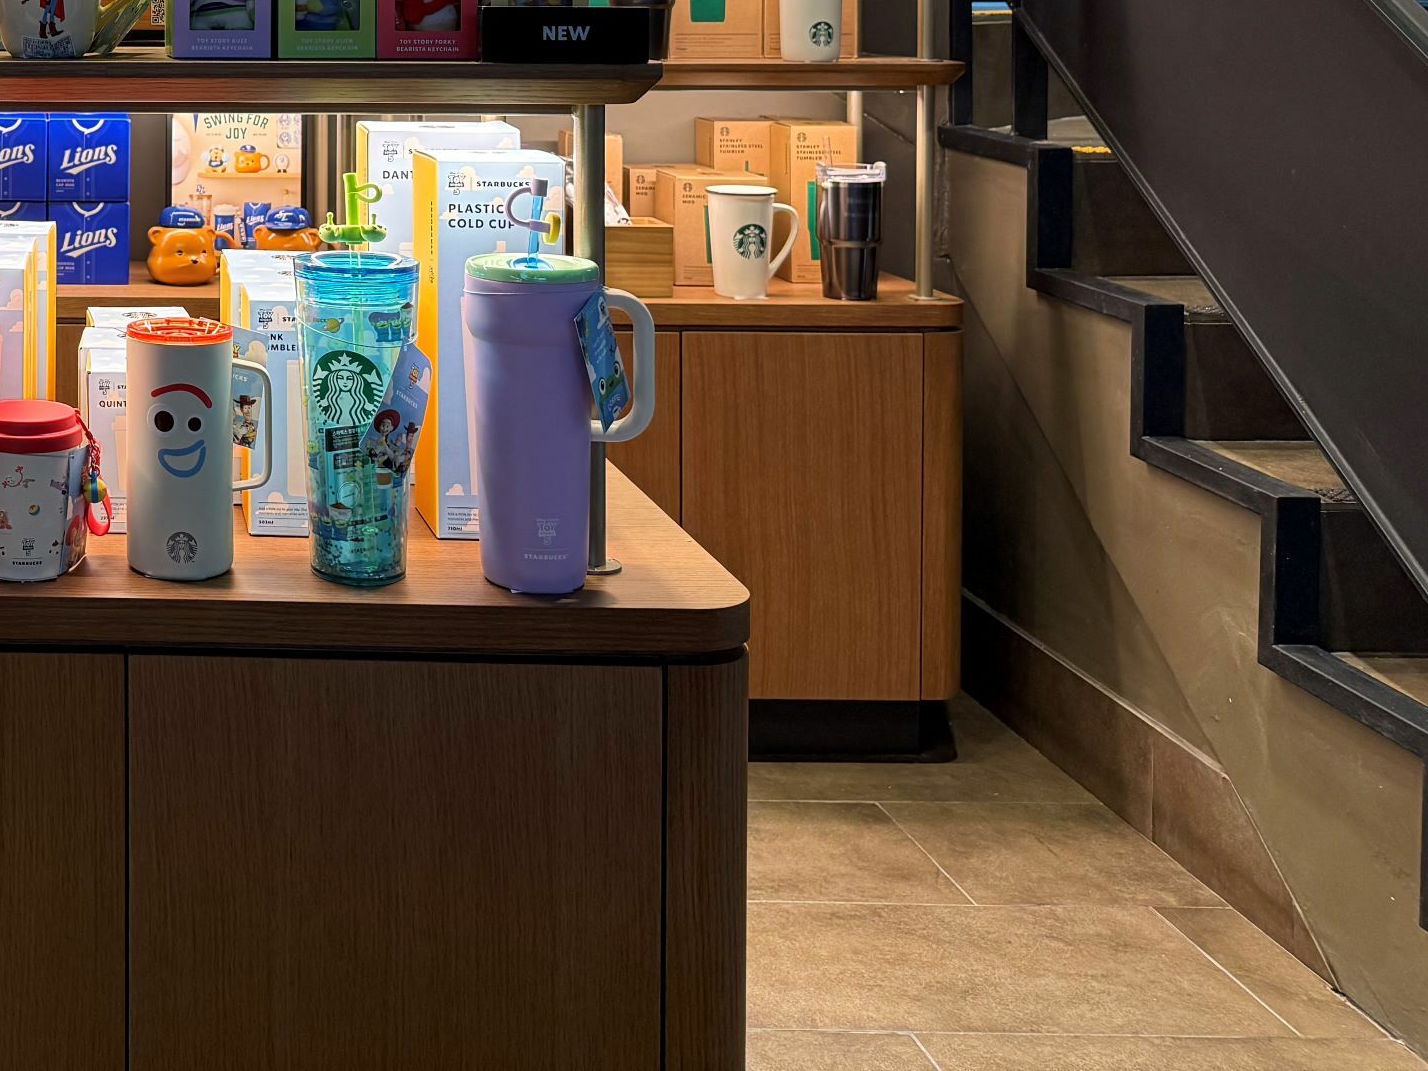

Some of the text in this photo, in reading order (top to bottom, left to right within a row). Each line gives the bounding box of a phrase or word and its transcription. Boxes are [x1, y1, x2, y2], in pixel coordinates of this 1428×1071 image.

[542, 25, 591, 41] NEW
[204, 113, 269, 129] SWING FOR
[225, 127, 247, 140] JOY
[60, 144, 118, 172] Lions
[476, 180, 530, 188] STARBUCKS
[448, 203, 504, 214] PLASTIC
[448, 218, 484, 229] COLD
[60, 227, 118, 256] Lions
[99, 400, 127, 408] QUINT
[396, 390, 418, 409] STARBUCKS
